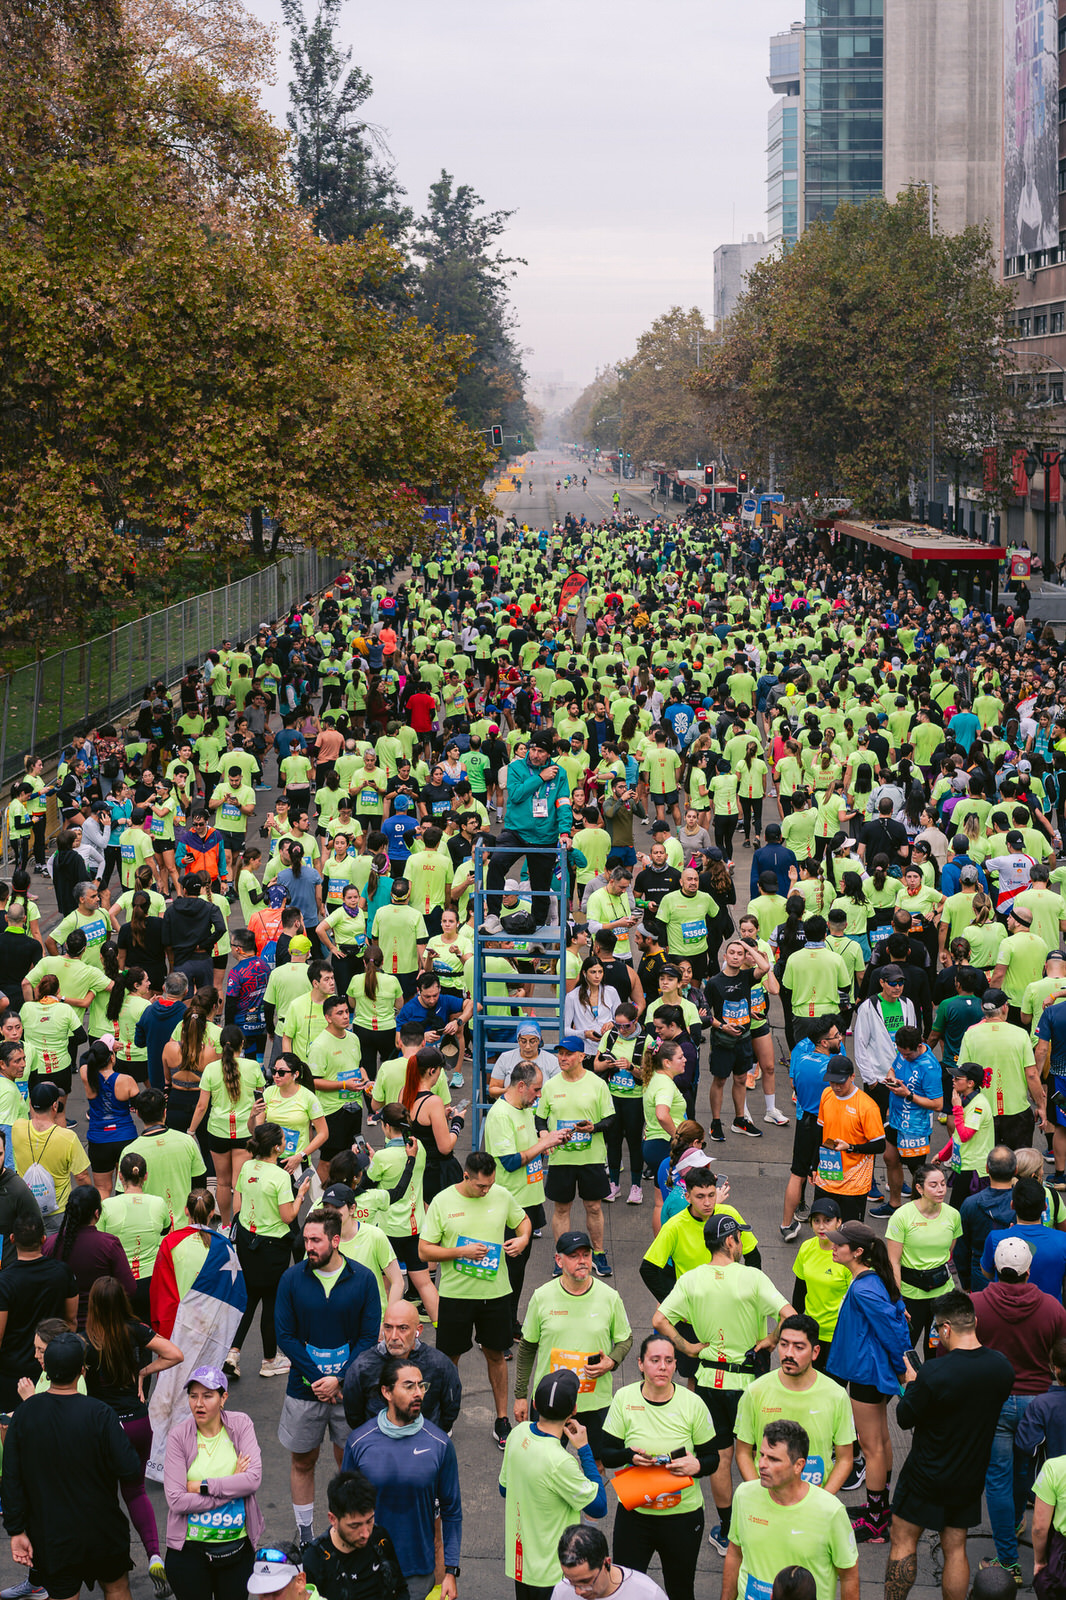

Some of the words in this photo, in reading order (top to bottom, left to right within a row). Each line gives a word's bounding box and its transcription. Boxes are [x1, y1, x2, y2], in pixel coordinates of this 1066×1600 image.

[900, 1137, 926, 1148] 41613
[353, 1208, 369, 1219] OS
[723, 1221, 736, 1231] 99
[802, 1472, 823, 1484] 78
